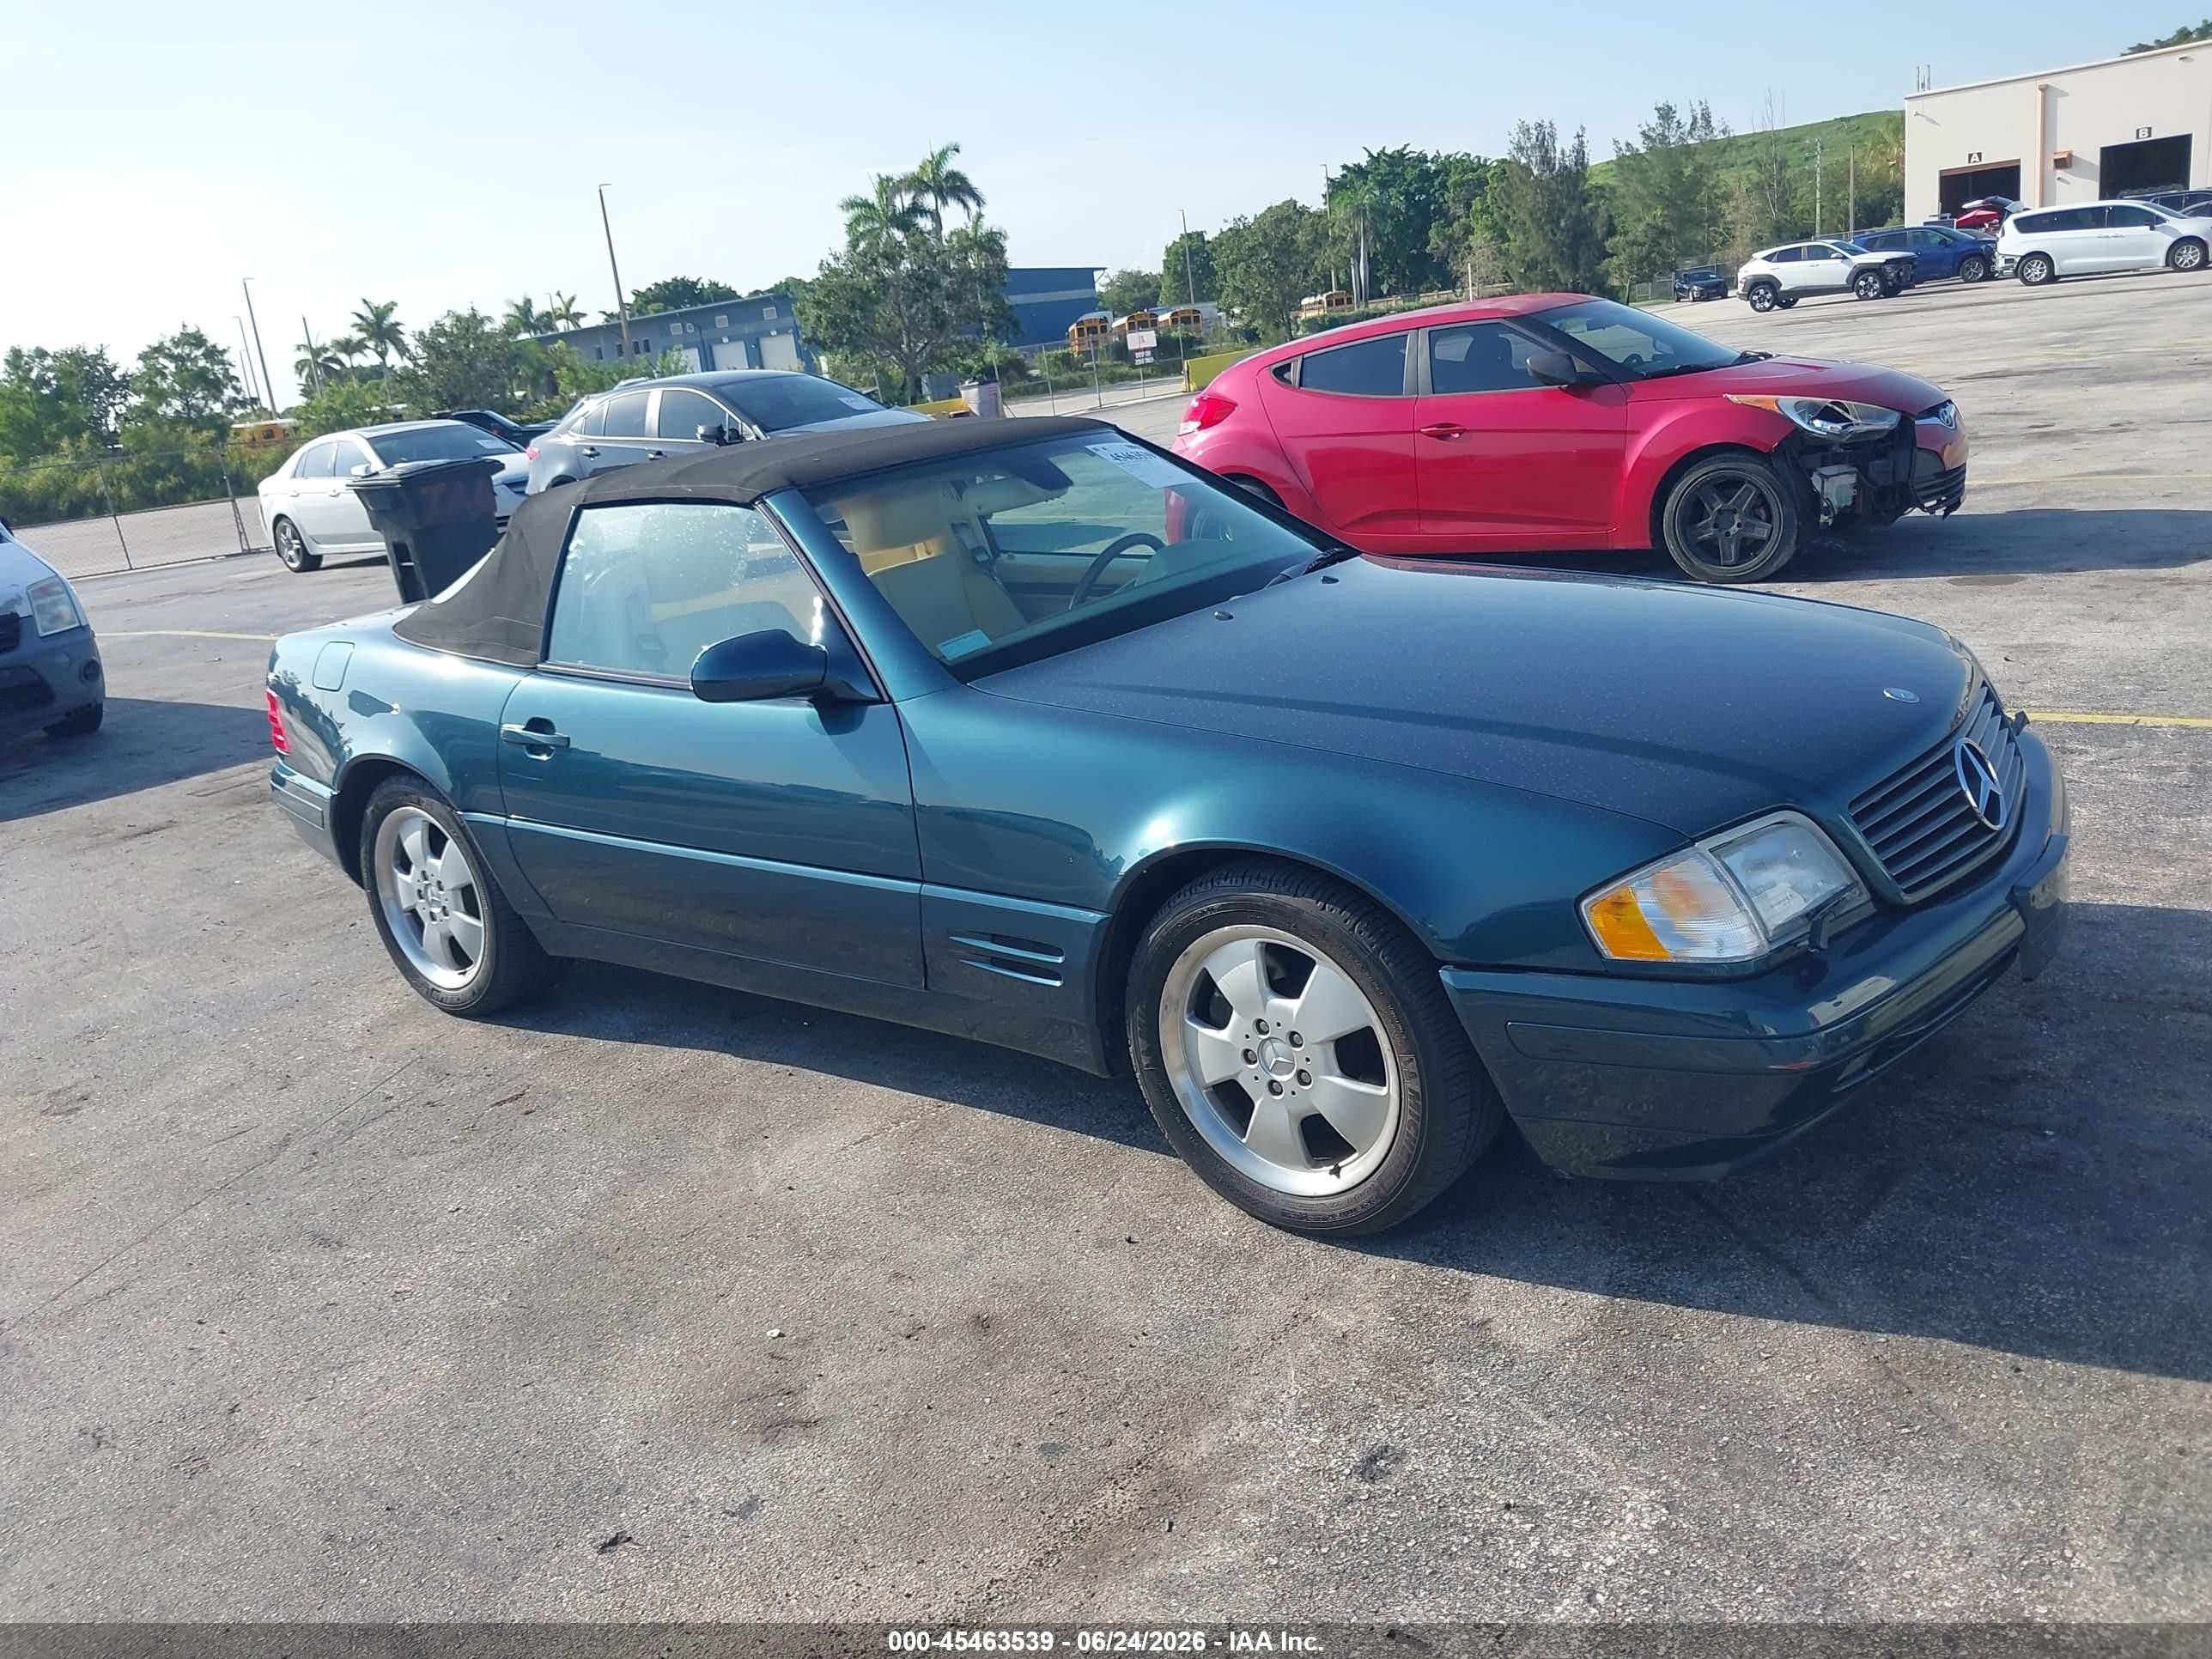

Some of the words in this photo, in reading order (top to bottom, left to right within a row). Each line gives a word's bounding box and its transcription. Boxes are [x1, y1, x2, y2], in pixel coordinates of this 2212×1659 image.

[2138, 128, 2148, 138] B
[1970, 153, 1980, 164] A
[1379, 1086, 1423, 1195] MICHE
